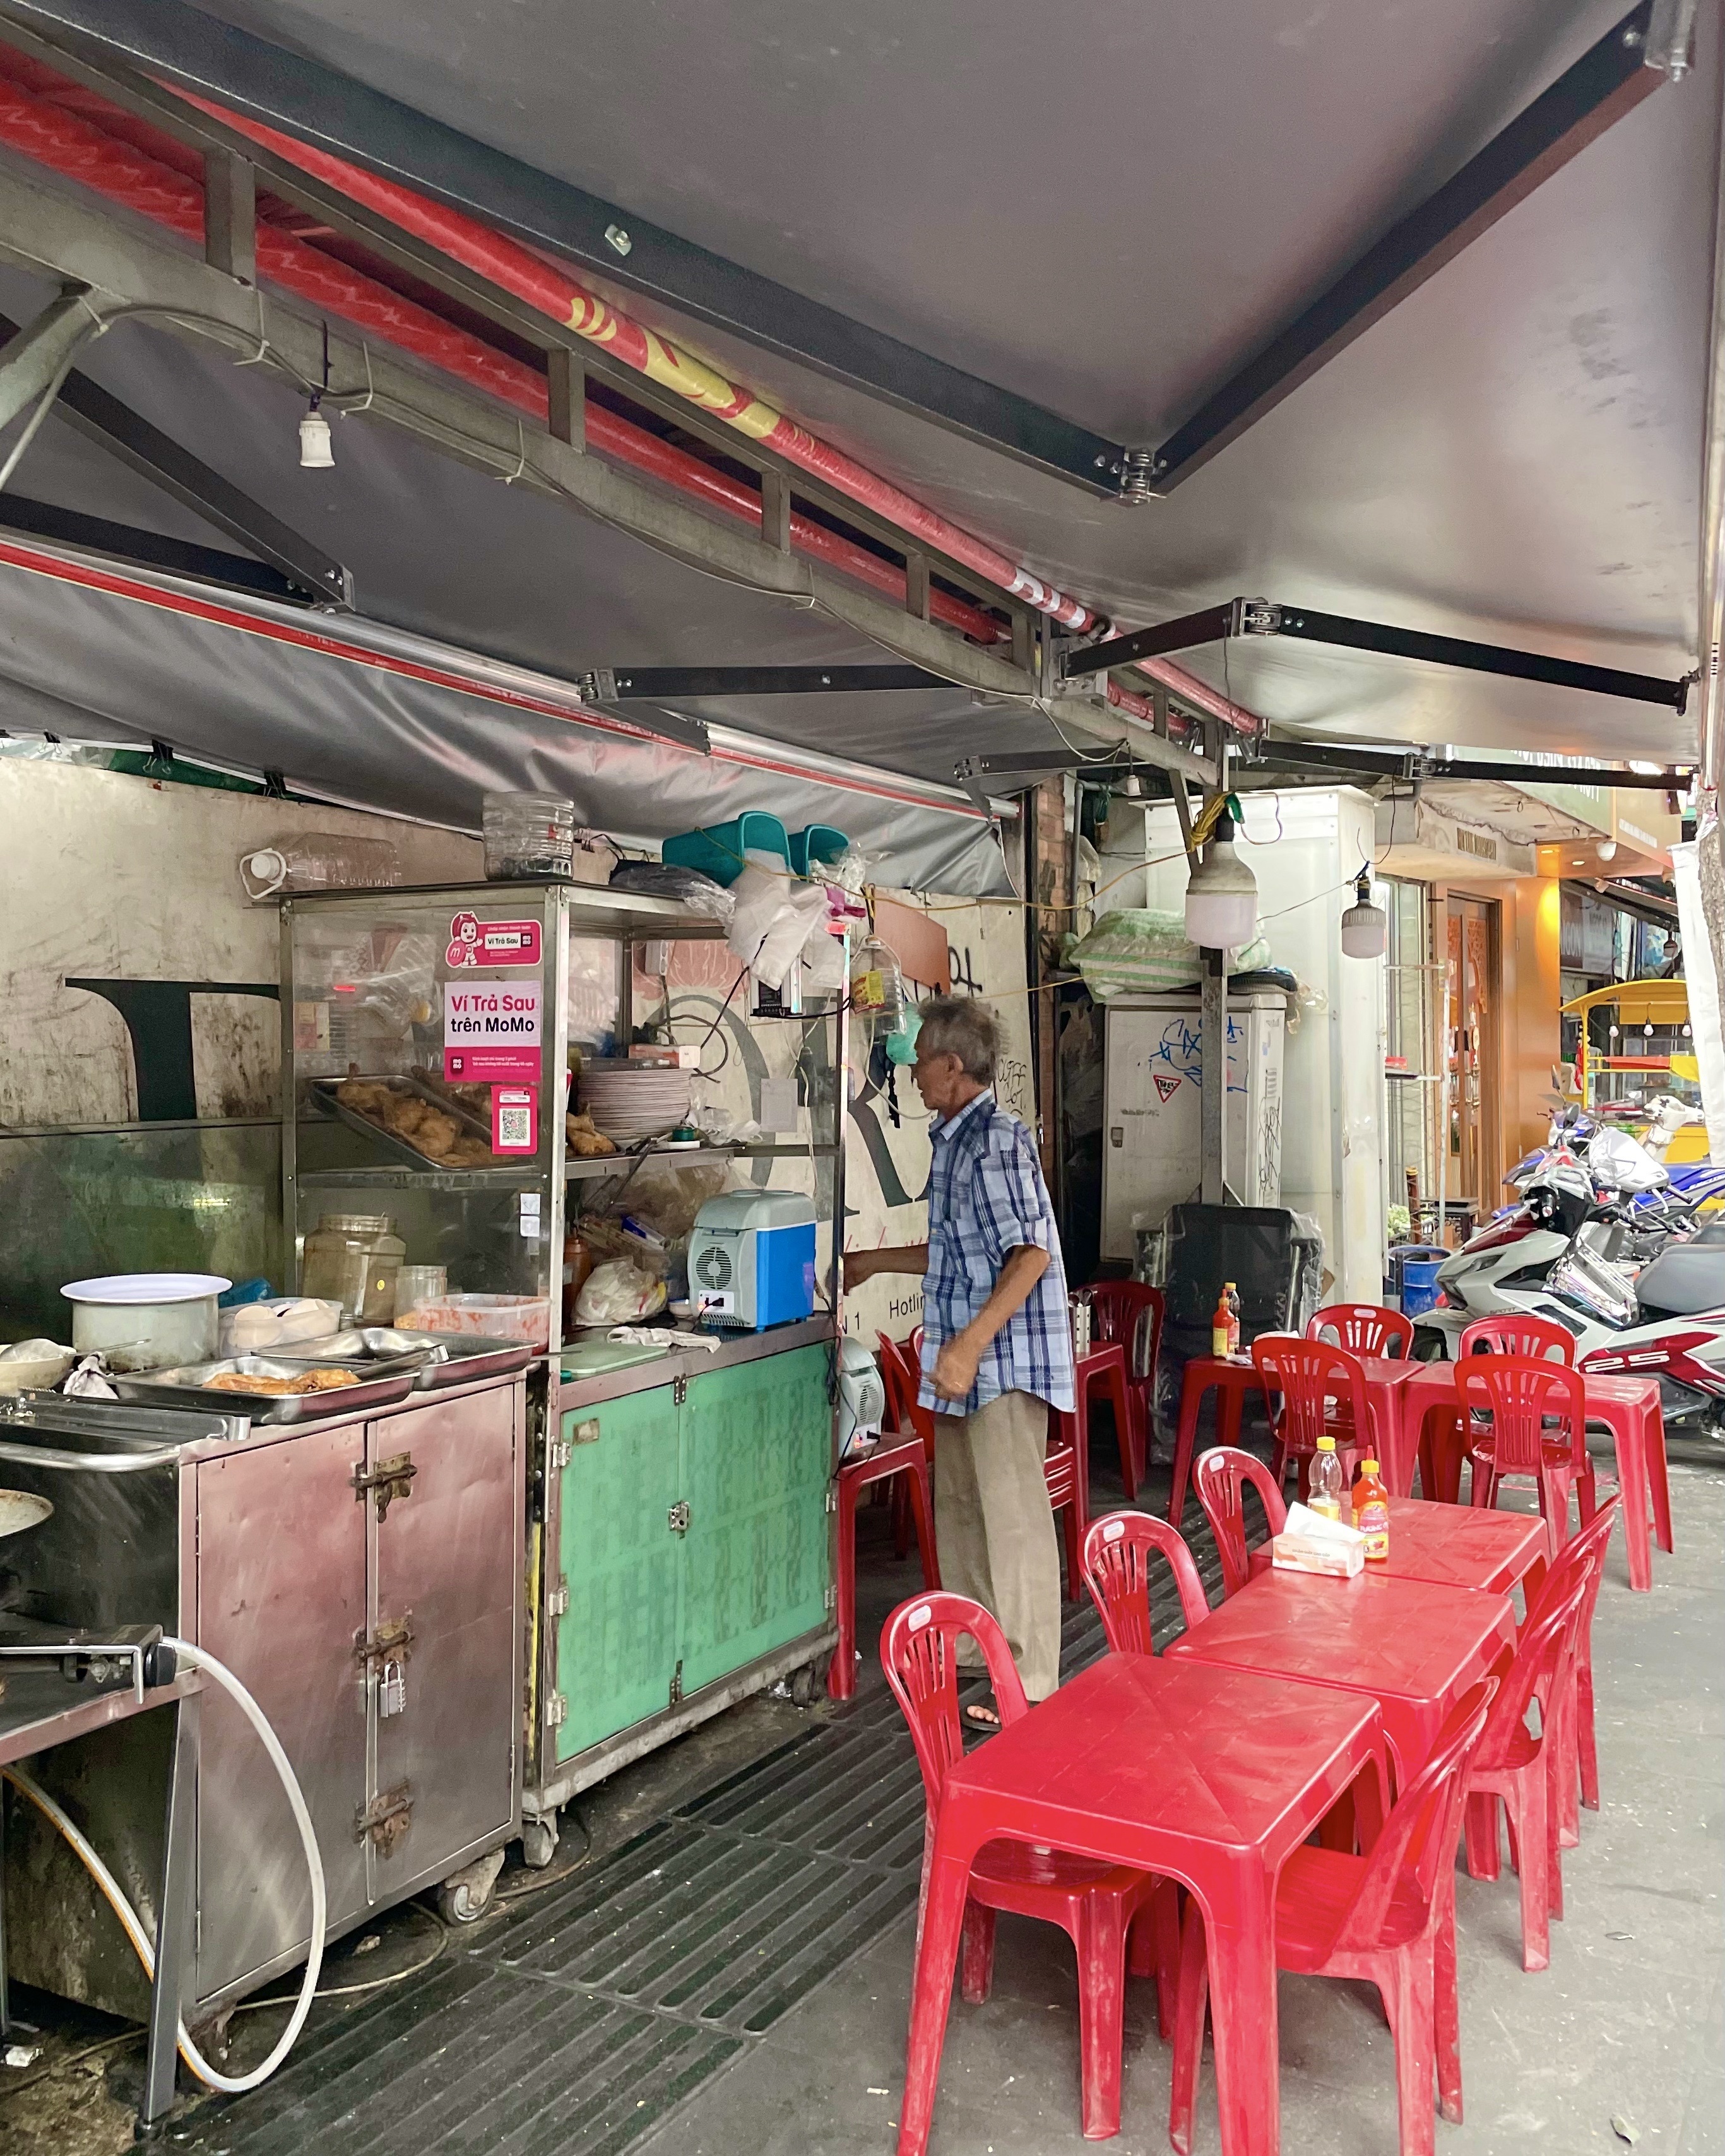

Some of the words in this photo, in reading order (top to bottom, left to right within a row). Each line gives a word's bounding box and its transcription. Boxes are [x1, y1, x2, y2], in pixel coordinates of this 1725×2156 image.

[451, 995, 468, 1012] Ví
[471, 994, 497, 1012] Trả
[502, 994, 535, 1012] Sau
[451, 1017, 481, 1033] trên
[485, 1017, 535, 1033] MoMo
[889, 1293, 926, 1320] Hotlin
